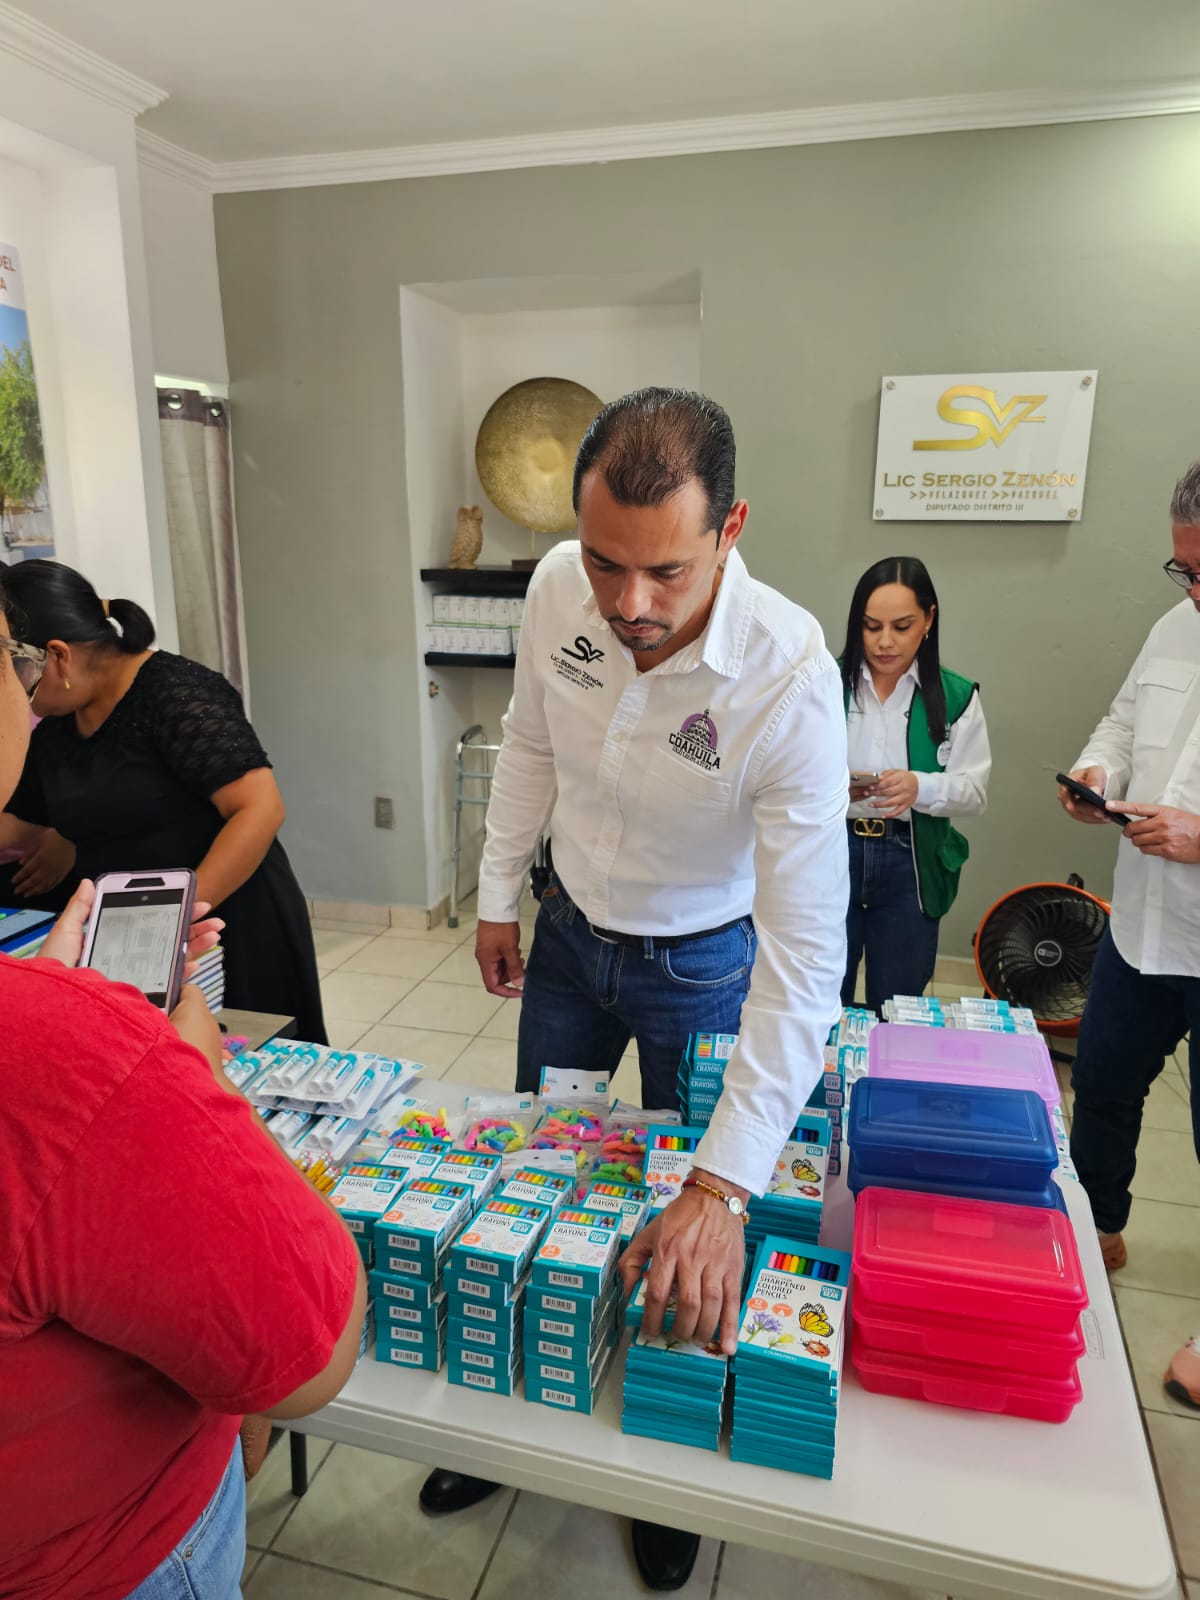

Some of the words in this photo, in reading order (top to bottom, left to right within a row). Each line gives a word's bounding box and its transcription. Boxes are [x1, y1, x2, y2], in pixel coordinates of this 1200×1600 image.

[922, 472, 997, 488] SERGIO
[1001, 470, 1077, 488] ZENÓN
[926, 503, 971, 511] DIPUTADO
[973, 503, 1013, 511] DISTRITO
[1015, 503, 1024, 511] III
[668, 733, 720, 769] COAHUILA
[479, 1216, 511, 1227] CRAYONS
[553, 1227, 587, 1237] CRAYONS
[757, 1282, 792, 1295] COLORED
[760, 1275, 806, 1291] SHARPENED
[755, 1288, 788, 1300] PENCILS
